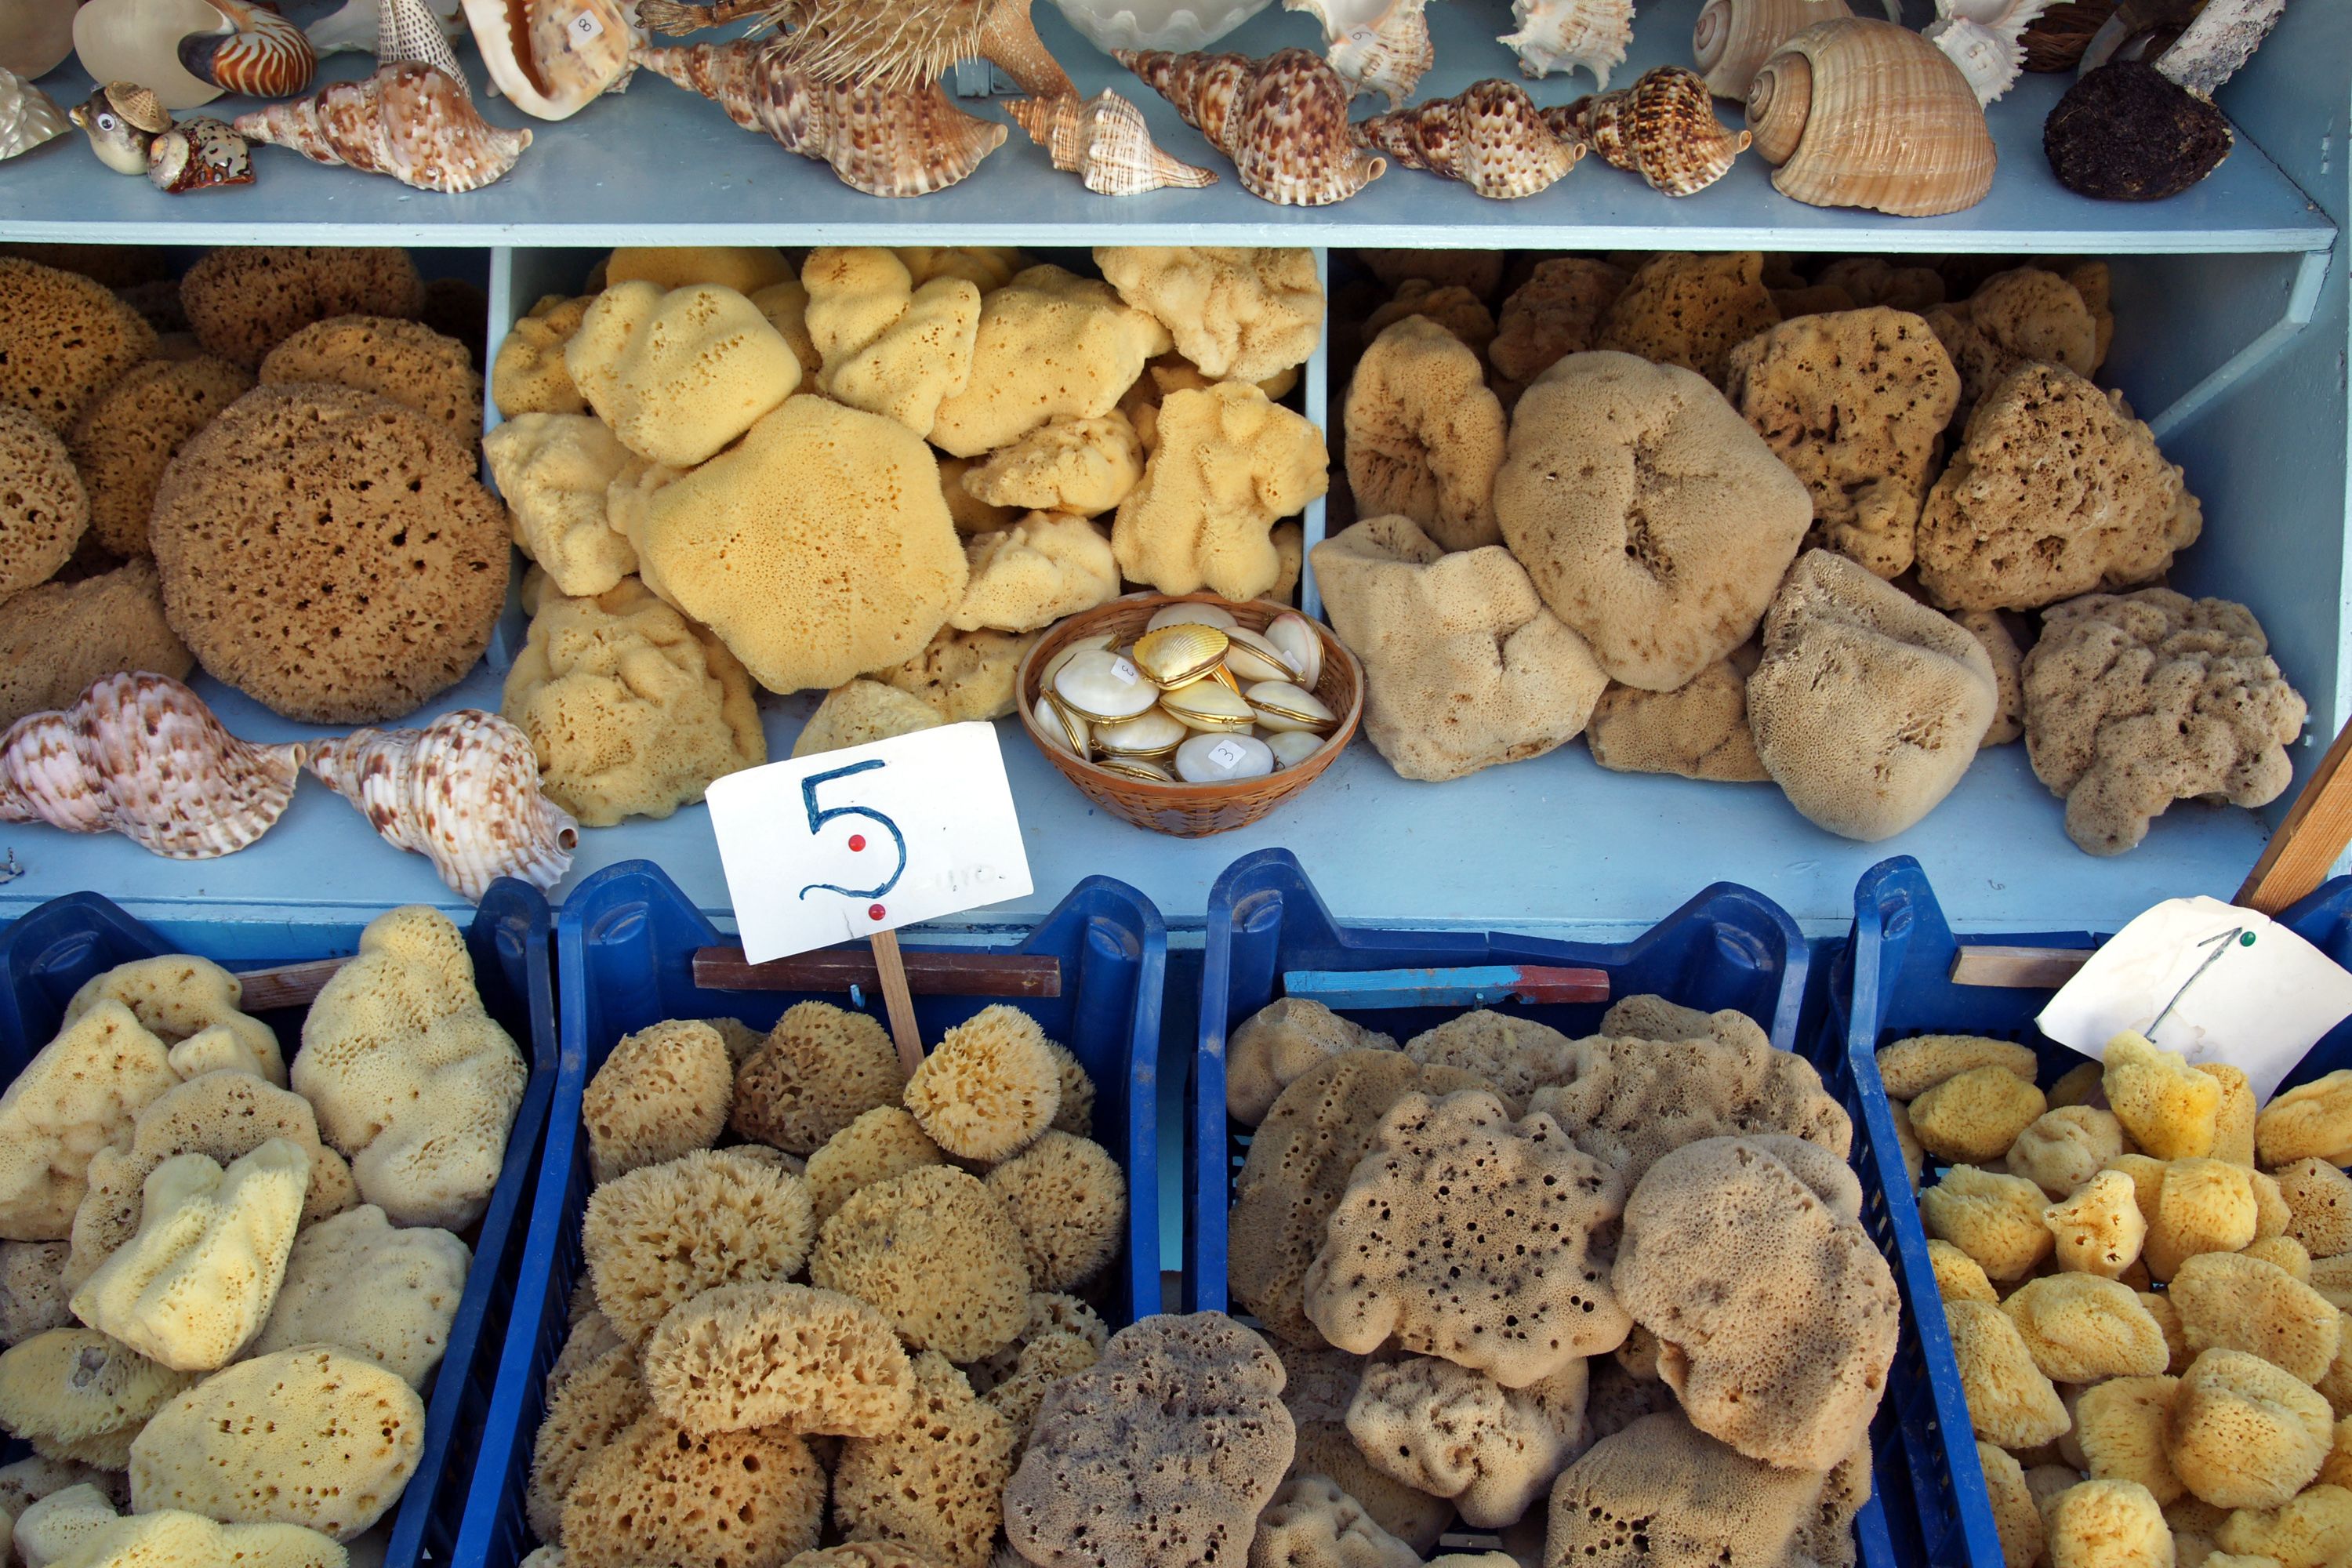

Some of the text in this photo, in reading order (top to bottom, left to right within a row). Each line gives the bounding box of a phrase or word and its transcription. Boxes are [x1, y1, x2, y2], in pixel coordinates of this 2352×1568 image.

[579, 18, 592, 32] 8
[1121, 665, 1134, 677] 3
[1218, 747, 1234, 762] 3
[799, 759, 907, 900] 5
